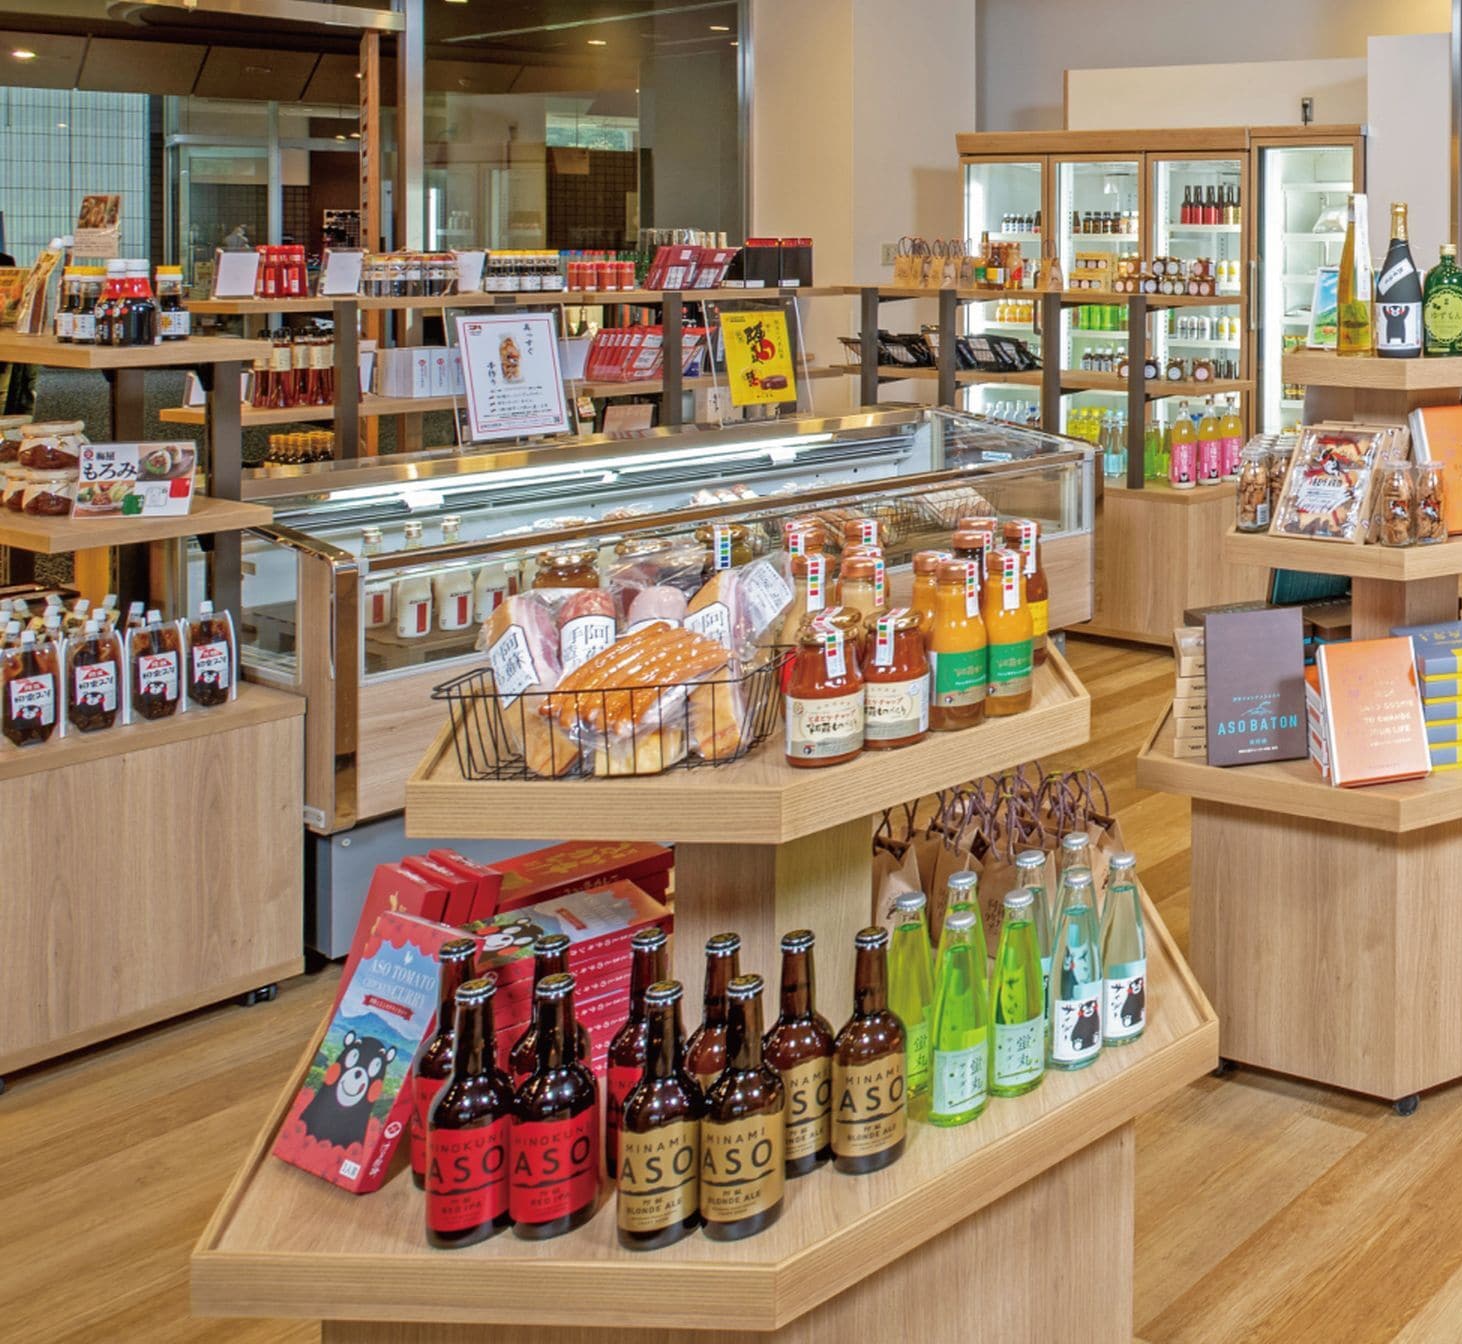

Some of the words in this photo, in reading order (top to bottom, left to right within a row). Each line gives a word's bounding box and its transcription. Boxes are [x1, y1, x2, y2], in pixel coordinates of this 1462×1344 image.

[83, 462, 137, 480] もろみ
[1218, 721, 1246, 735] ASO
[1250, 714, 1298, 733] BATON
[371, 959, 392, 977] ASO
[391, 965, 436, 990] TOMATO
[391, 984, 425, 1008] CURRY
[845, 1066, 900, 1085] MINAMI
[839, 1076, 904, 1113] ASO
[706, 1127, 766, 1145] MINAMI
[882, 1124, 897, 1135] ALE
[625, 1135, 687, 1153] MINAMI
[429, 1145, 505, 1184] ASO
[514, 1136, 591, 1177] ASO
[621, 1146, 693, 1184] ASO
[702, 1139, 773, 1175] ASO
[626, 1204, 663, 1216] BLONDE
[665, 1198, 682, 1209] ALE
[707, 1195, 742, 1206] BLONDE
[744, 1189, 761, 1201] ALE
